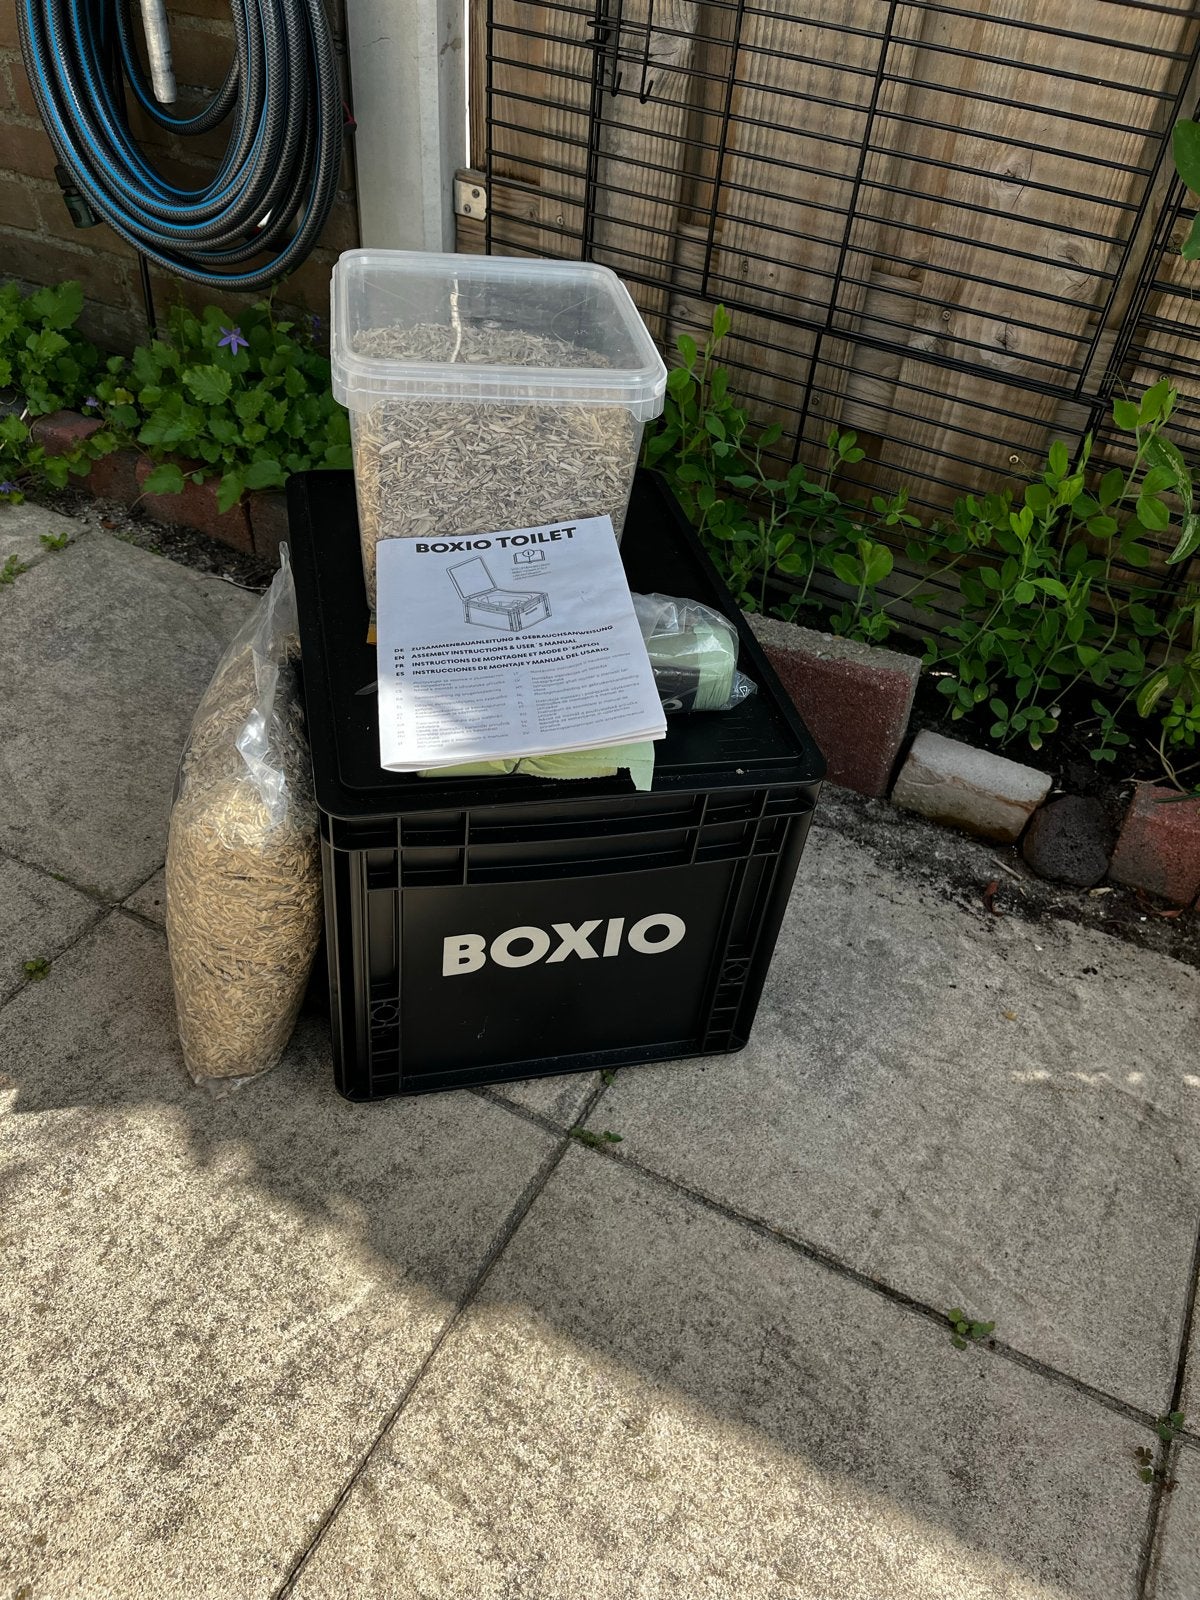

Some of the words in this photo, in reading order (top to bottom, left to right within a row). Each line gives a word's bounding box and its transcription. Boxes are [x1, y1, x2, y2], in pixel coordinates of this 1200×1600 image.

[415, 539, 492, 553] BOXIO
[495, 527, 577, 549] TOILET
[411, 637, 514, 651] ZUSAMMENBAUANLEITUNG
[522, 625, 614, 640] GEBRAUCHSANWEISUNG
[411, 650, 450, 659] ASSEMBLY
[450, 645, 508, 656] INSTRUCTIONS
[544, 638, 577, 647] MANUAL
[412, 658, 471, 667] INSTRUCTIONS
[482, 652, 528, 662] MONTAGNE
[538, 648, 562, 656] MODE
[412, 666, 476, 675] INSTRUCCIONES
[488, 661, 525, 670] MONTAJE
[532, 656, 565, 665] MANUAL
[442, 913, 686, 977] BOXIO
